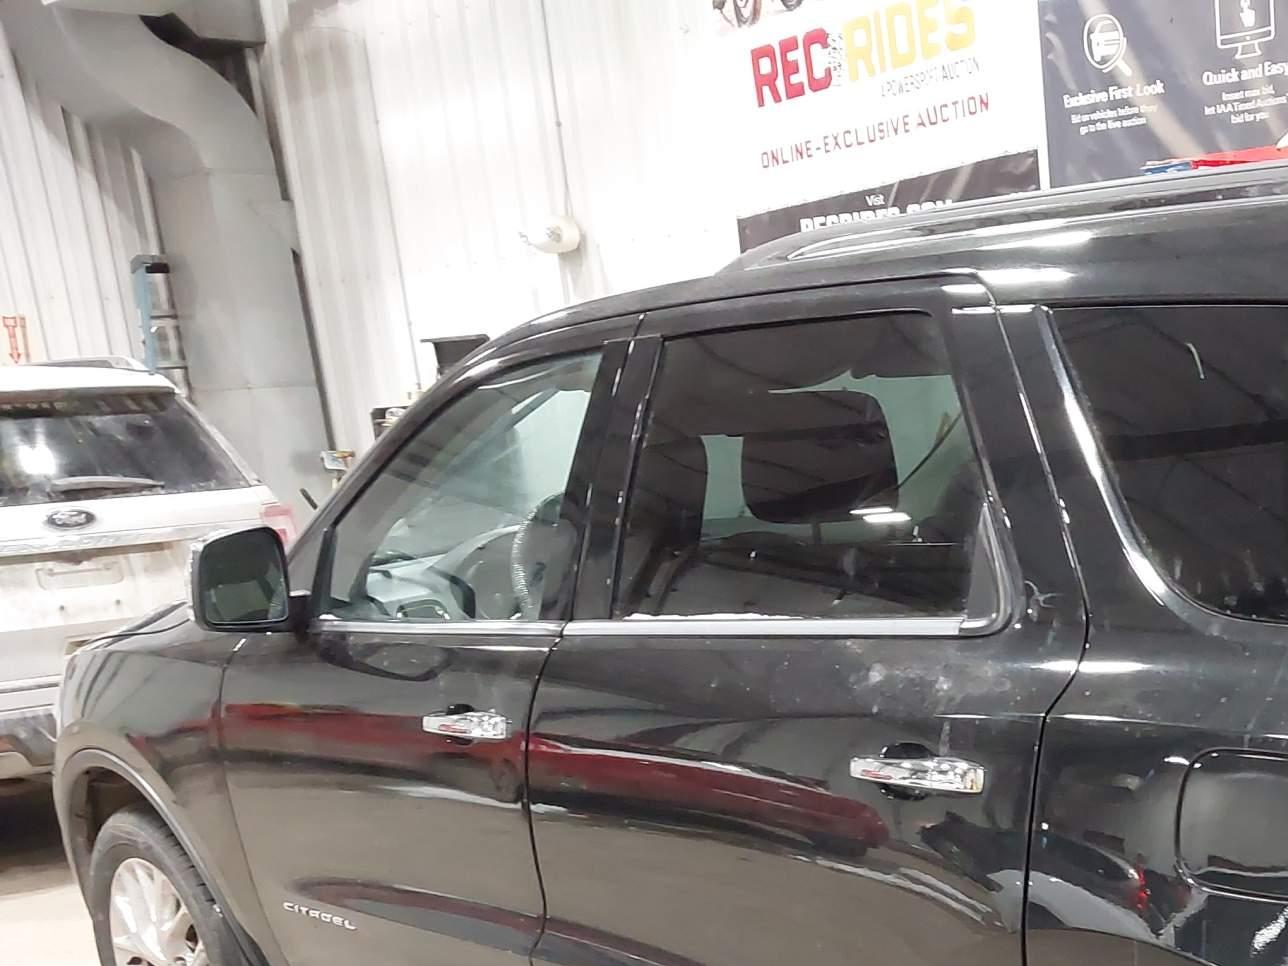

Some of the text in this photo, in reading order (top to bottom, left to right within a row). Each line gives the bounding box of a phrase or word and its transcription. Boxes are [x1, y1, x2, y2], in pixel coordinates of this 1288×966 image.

[751, 0, 976, 107] REC RIDES
[1202, 68, 1240, 86] Quick
[1240, 63, 1263, 80] and
[1063, 80, 1165, 108] Exclusive First Look
[1216, 103, 1233, 113] IAA
[761, 93, 990, 169] ONLINE-EXCLUSIVE AUCTION
[1107, 120, 1122, 129] live
[800, 199, 953, 233] RECRIDESCO
[283, 902, 357, 930] CITADEL
